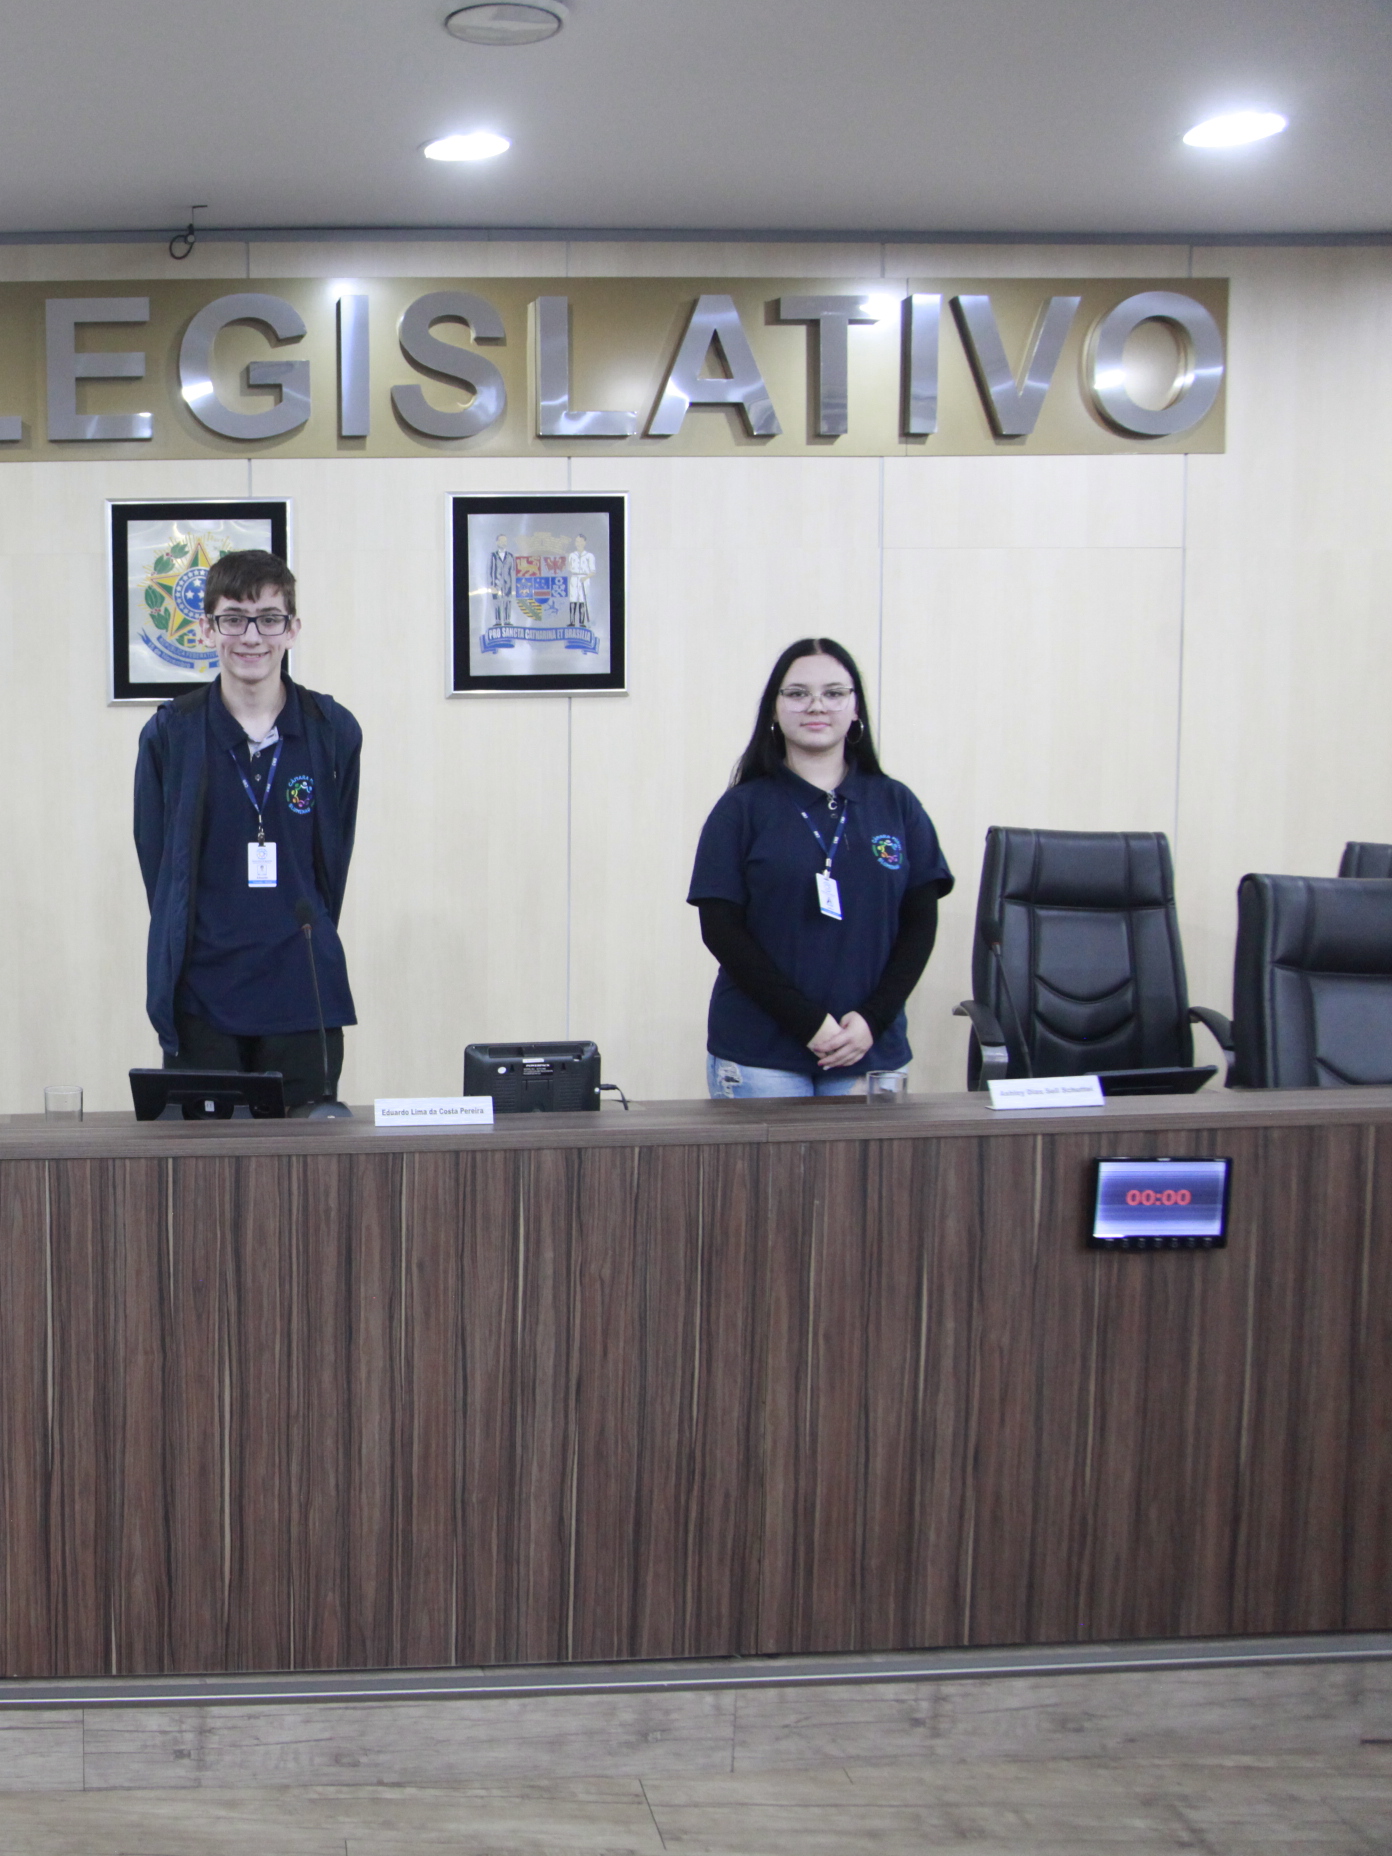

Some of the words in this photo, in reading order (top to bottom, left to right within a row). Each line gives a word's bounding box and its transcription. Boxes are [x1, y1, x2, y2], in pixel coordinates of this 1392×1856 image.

[489, 628, 501, 640] PRO
[502, 627, 524, 638] SANCTA
[557, 629, 564, 639] ET
[381, 1108, 409, 1116] Eduardo
[439, 1107, 458, 1115] Costa
[1125, 1189, 1192, 1206] 00:00
